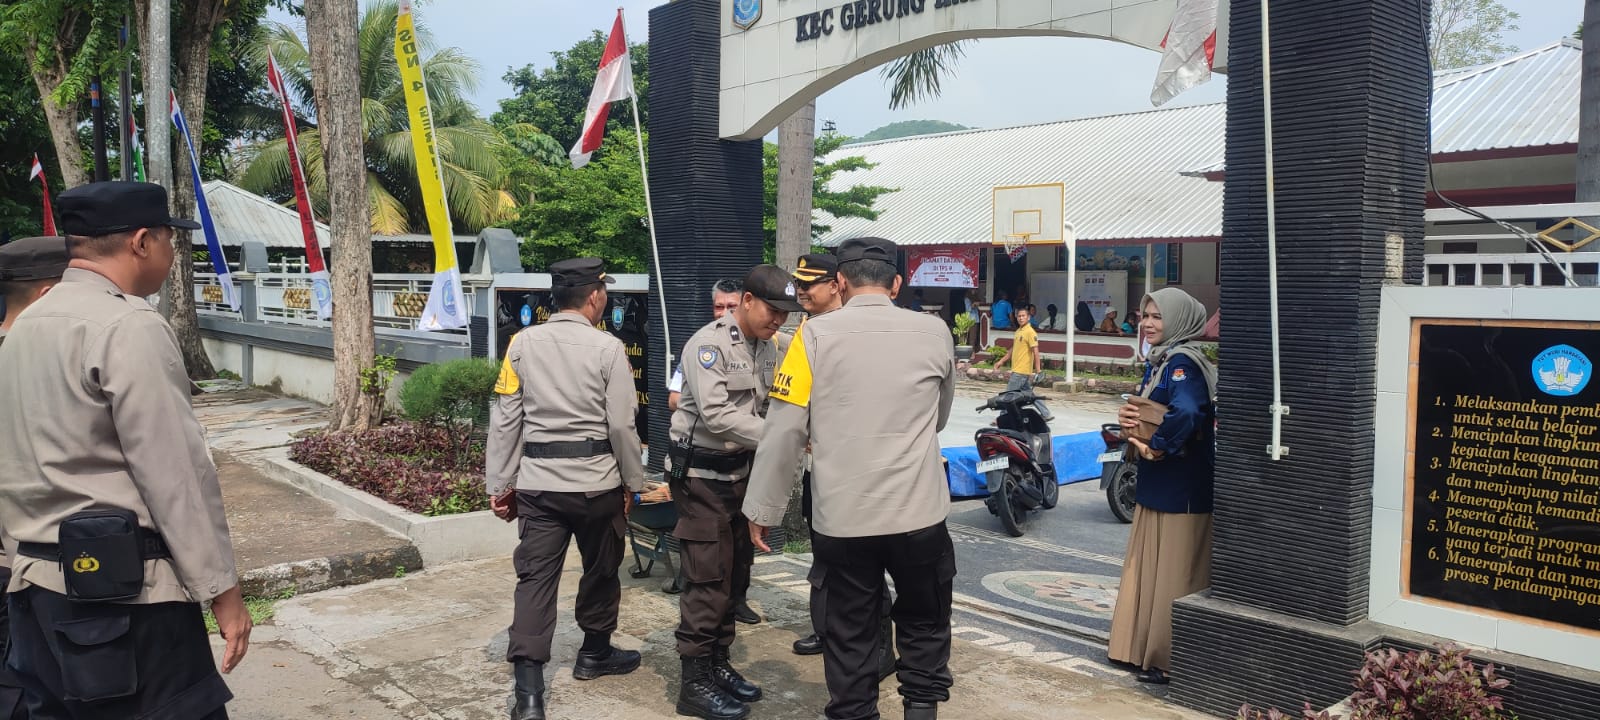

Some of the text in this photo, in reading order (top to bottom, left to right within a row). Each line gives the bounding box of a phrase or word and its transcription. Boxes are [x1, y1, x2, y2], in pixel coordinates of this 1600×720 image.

[795, 0, 927, 42] KEC GERUNG
[1434, 395, 1446, 406] 1.
[1454, 394, 1558, 415] Melaksanakan
[1431, 427, 1444, 437] 2.
[1450, 425, 1540, 446] Menciptakan
[1453, 412, 1598, 437] untuk selalu belajar
[1451, 441, 1599, 470] kegiatan keagamaan
[1430, 456, 1600, 486] 3. Menciptakan lingkun
[1428, 489, 1440, 502] 4.
[1446, 489, 1533, 513] Menerapkan
[1446, 472, 1599, 506] dan menjunjung nilai
[1445, 505, 1539, 531] peserta didik.
[1427, 519, 1439, 532] 5.
[1445, 519, 1535, 545] Menerapkan
[1445, 536, 1481, 554] yang
[1484, 541, 1533, 560] terjadi
[1536, 551, 1582, 568] untuk
[1428, 547, 1440, 561] 6.
[1445, 549, 1535, 576] Menerapkan
[1538, 565, 1567, 584] dan
[1443, 567, 1490, 585] proses
